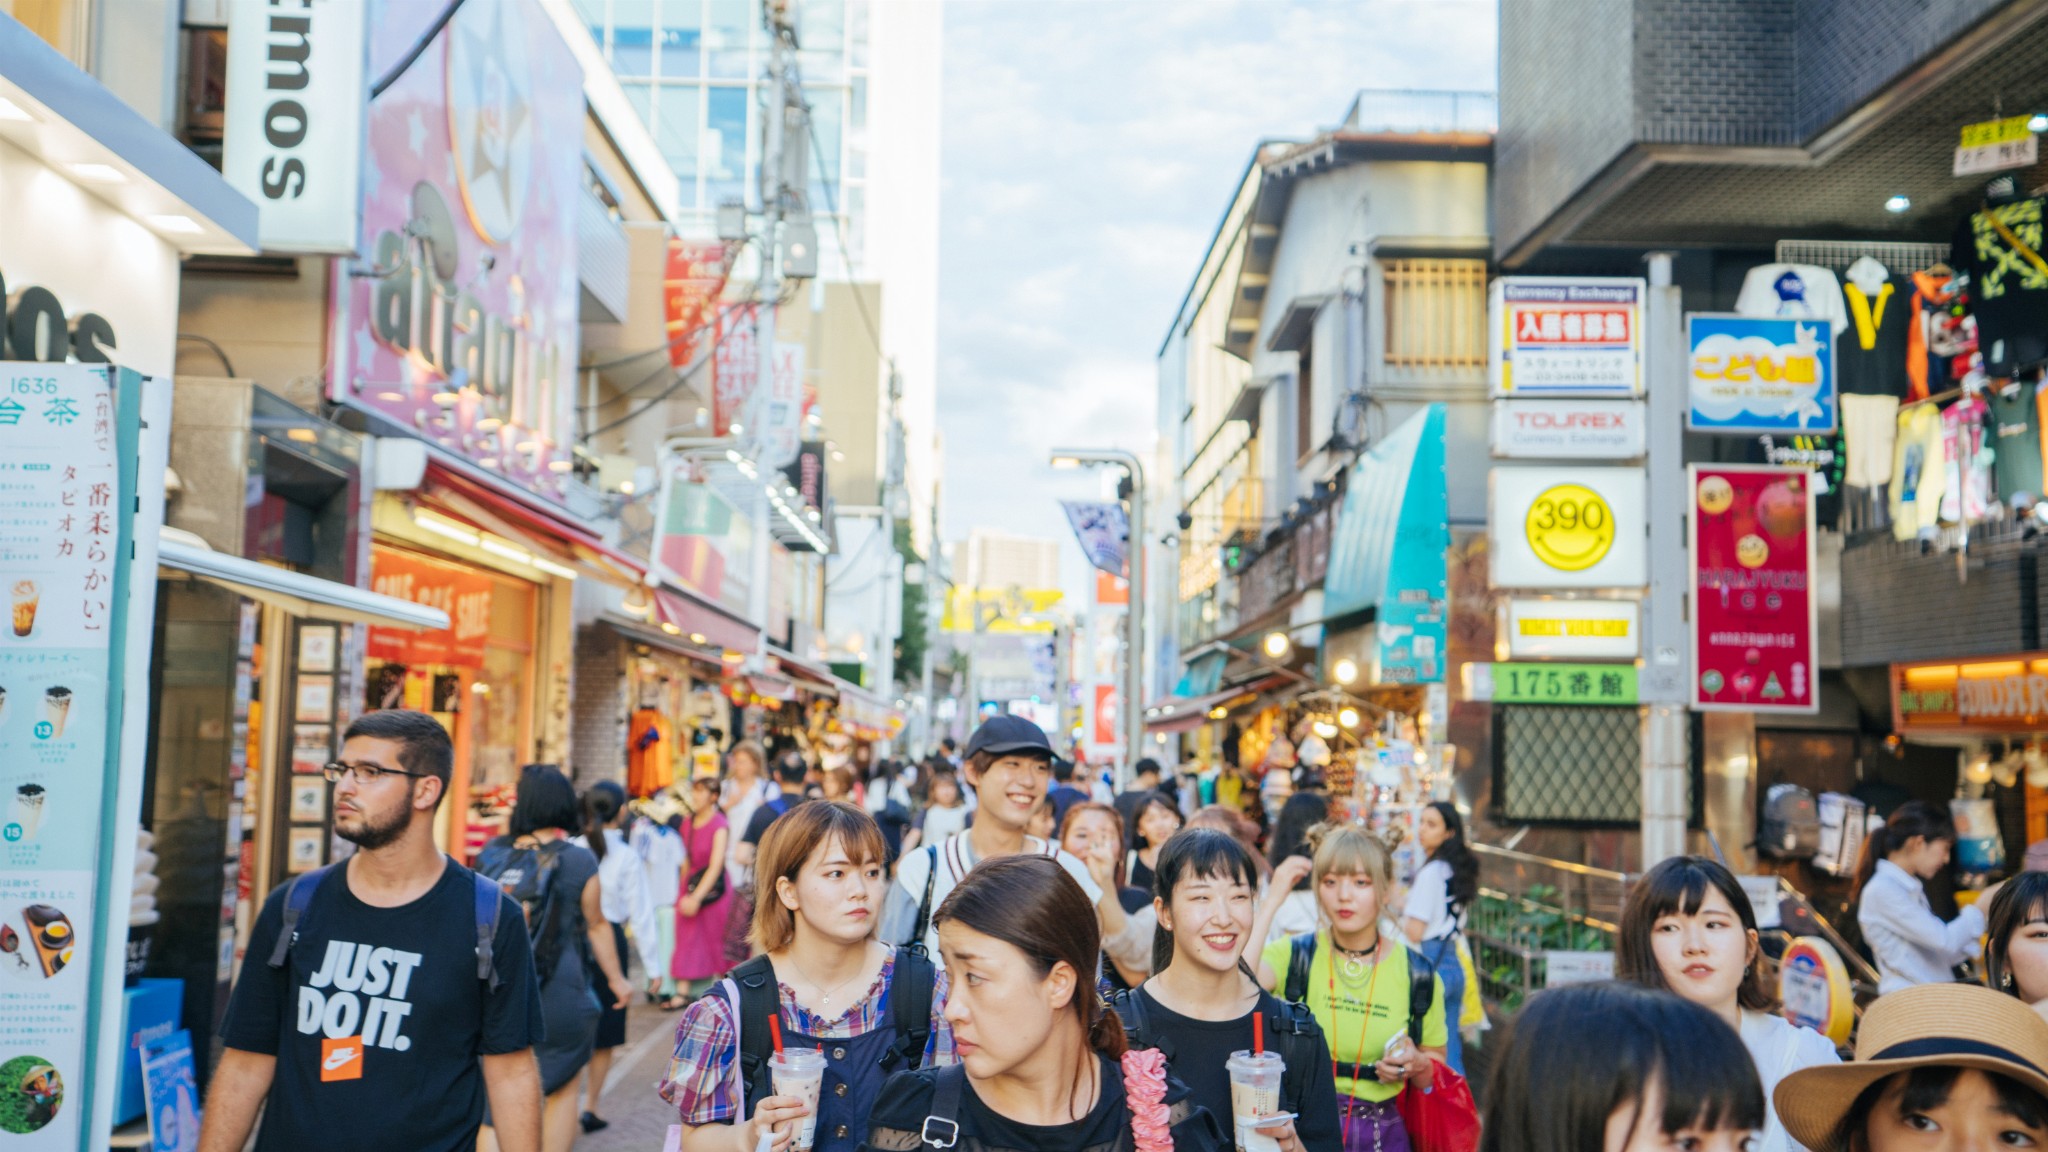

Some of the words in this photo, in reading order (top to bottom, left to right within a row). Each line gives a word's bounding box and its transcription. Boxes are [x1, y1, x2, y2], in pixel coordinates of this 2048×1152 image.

[261, 0, 312, 200] mos
[1506, 286, 1566, 301] Currency
[1569, 286, 1633, 302] Exchange
[11, 377, 58, 395] 1636
[1513, 412, 1626, 429] TOUREX
[55, 463, 78, 560] タピオカ
[1535, 500, 1605, 531] 390
[1509, 670, 1624, 697] 175番館
[37, 725, 51, 735] 13
[6, 828, 19, 837] 15
[309, 940, 423, 999] JUST
[297, 986, 361, 1040] DO
